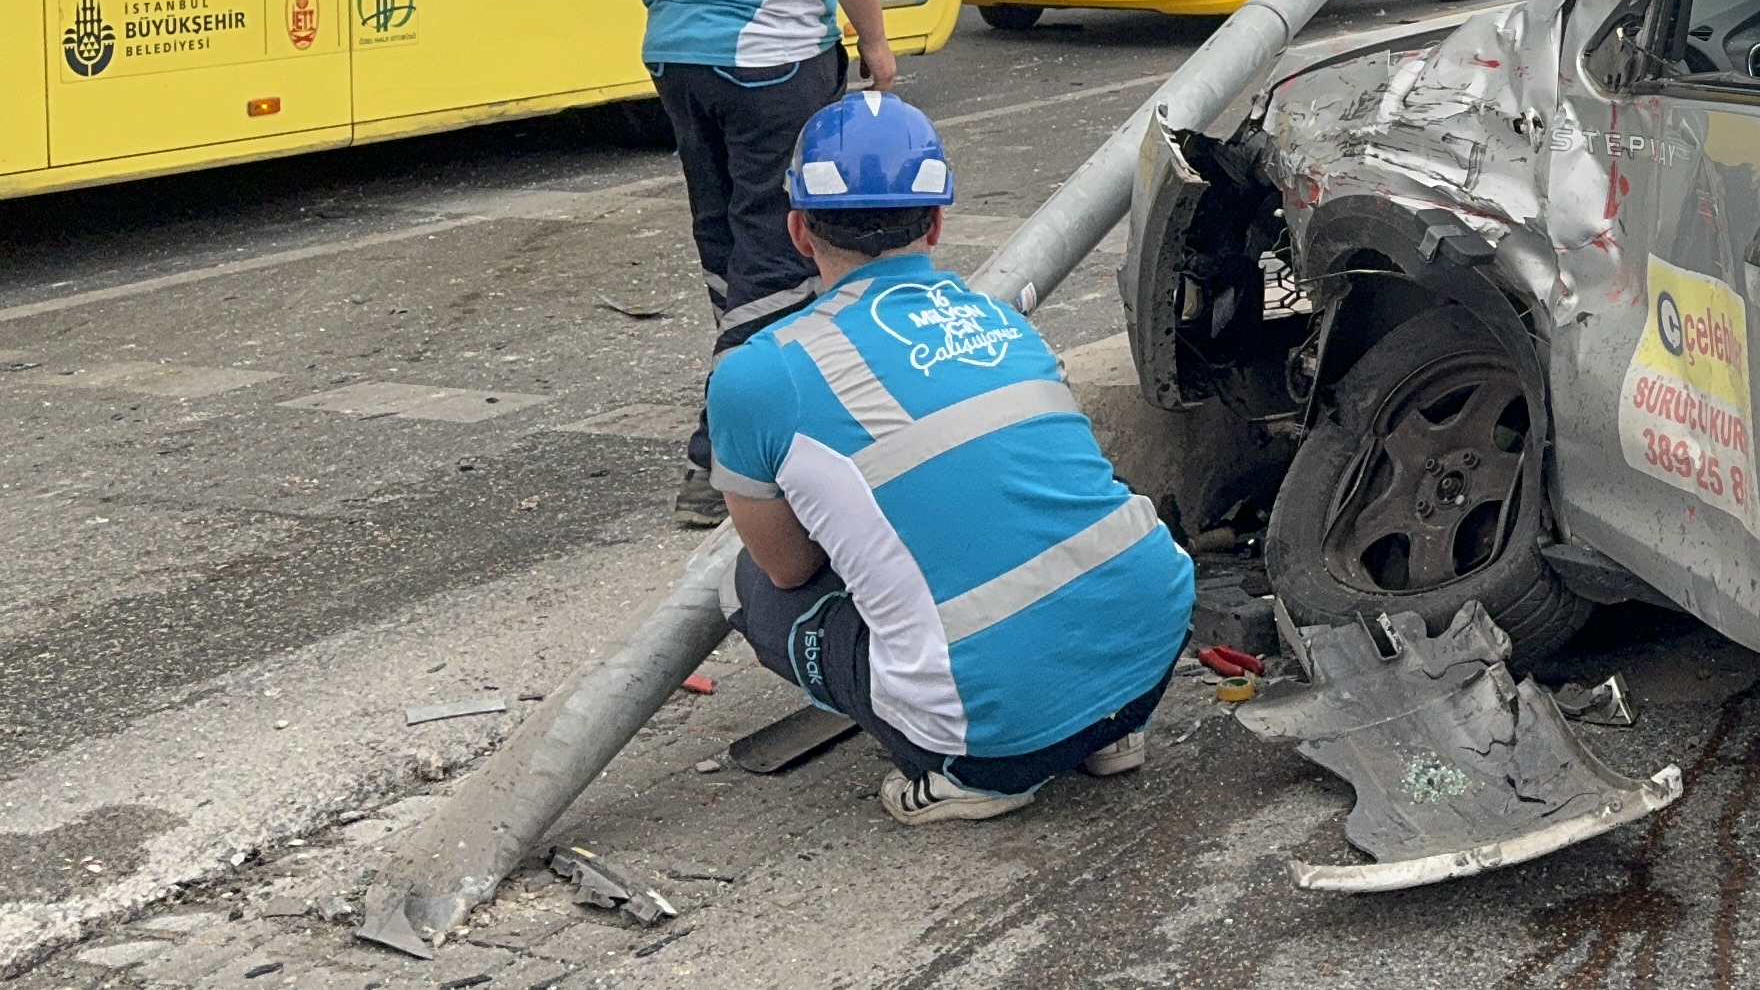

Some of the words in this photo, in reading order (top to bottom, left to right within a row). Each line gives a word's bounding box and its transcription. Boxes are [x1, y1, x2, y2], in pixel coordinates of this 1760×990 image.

[125, 9, 246, 39] BÜYÜKŞEHİR
[125, 36, 211, 58] BELEDİYESİ
[926, 289, 950, 308] 16
[1709, 405, 1750, 464] KUR
[1642, 427, 1693, 478] 389
[1696, 450, 1724, 496] 25
[1729, 464, 1748, 514] 8
